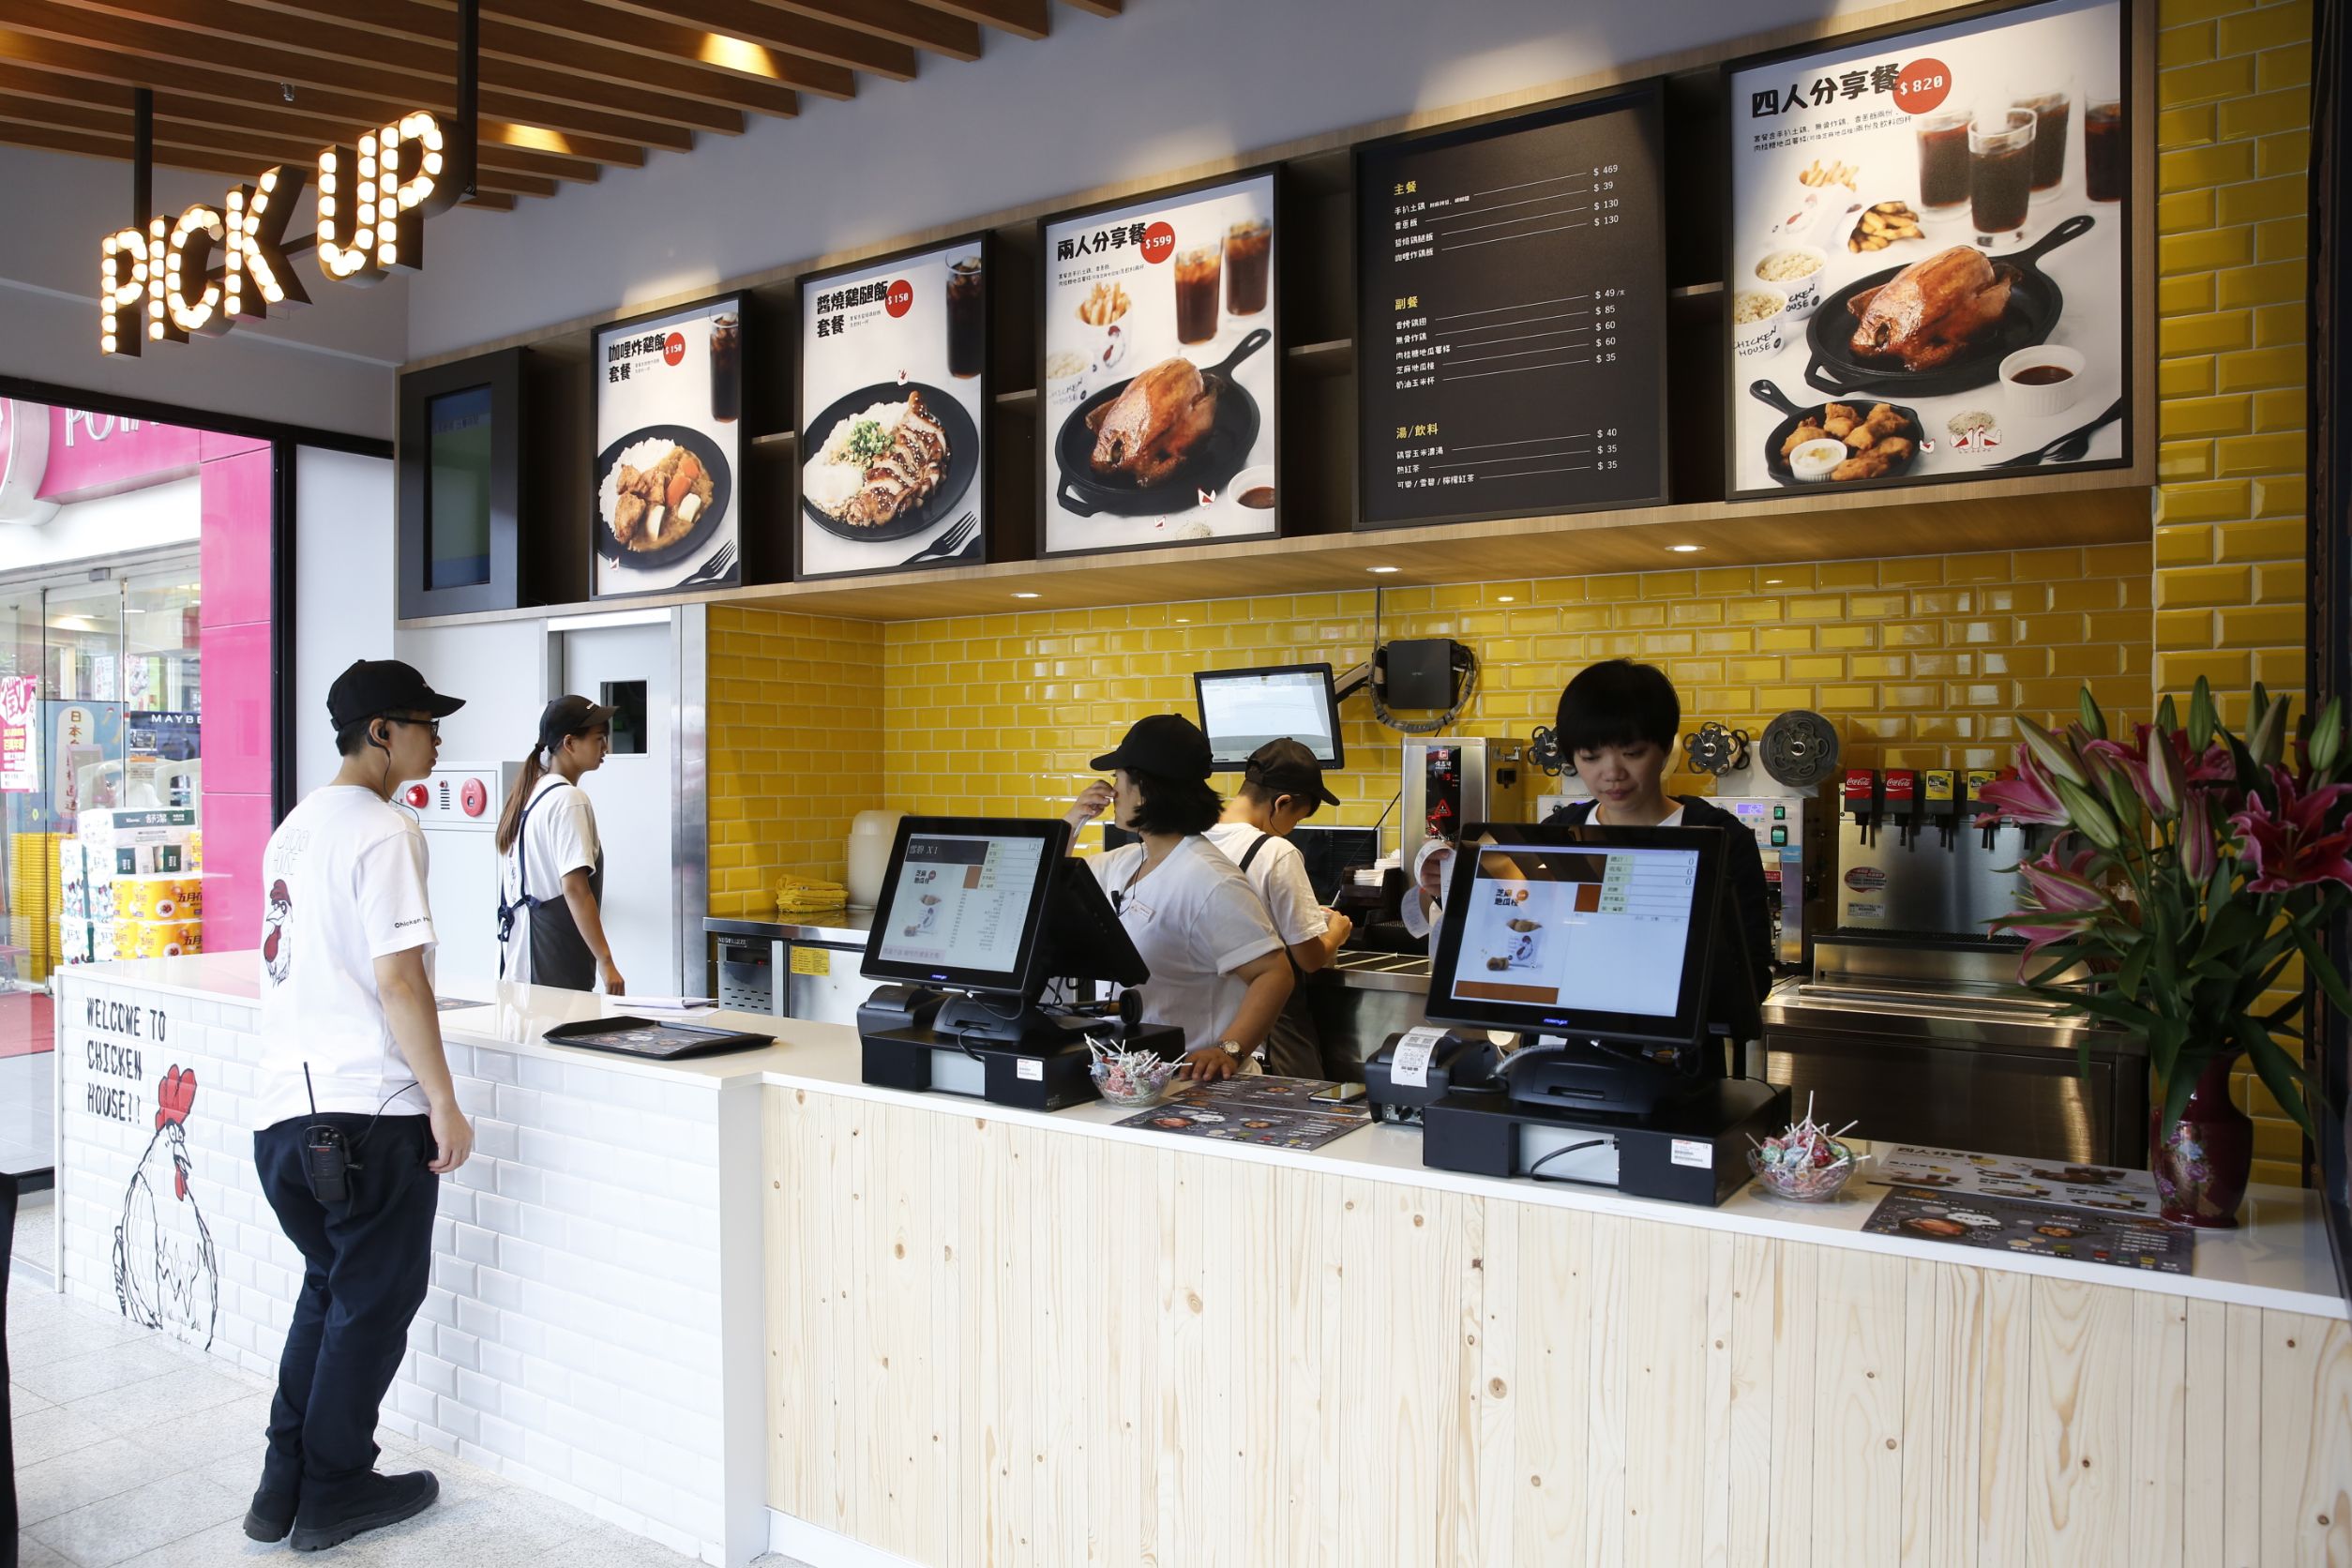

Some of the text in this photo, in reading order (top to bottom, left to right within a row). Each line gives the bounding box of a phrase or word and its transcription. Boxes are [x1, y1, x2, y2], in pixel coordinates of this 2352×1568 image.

[1912, 75, 1943, 93] 820
[1752, 63, 1900, 118] 四人分享餐
[1603, 164, 1619, 174] 469
[1394, 181, 1417, 196] 主餐
[1603, 181, 1613, 190] 39
[1604, 199, 1619, 209] 130
[1604, 215, 1619, 225] 130
[100, 110, 462, 357] PICK UP
[1057, 222, 1146, 262] 兩人分享餐
[1153, 234, 1172, 248] 599
[1605, 288, 1615, 297] 49
[1788, 283, 1816, 303] CKEN
[894, 293, 909, 304] 150
[1605, 305, 1616, 314] 85
[1786, 300, 1809, 312] OUSE
[817, 314, 845, 338] 套餐
[1605, 321, 1616, 330] 60
[1606, 337, 1616, 346] 60
[1606, 353, 1617, 362] 35
[609, 362, 631, 384] 套餐
[1606, 428, 1618, 437] 40
[1606, 444, 1618, 453] 35
[1606, 460, 1618, 469] 35
[86, 997, 167, 1042] WELCOME TO
[86, 1040, 143, 1081] CHICKEN
[87, 1082, 142, 1124] HOUSE!!
